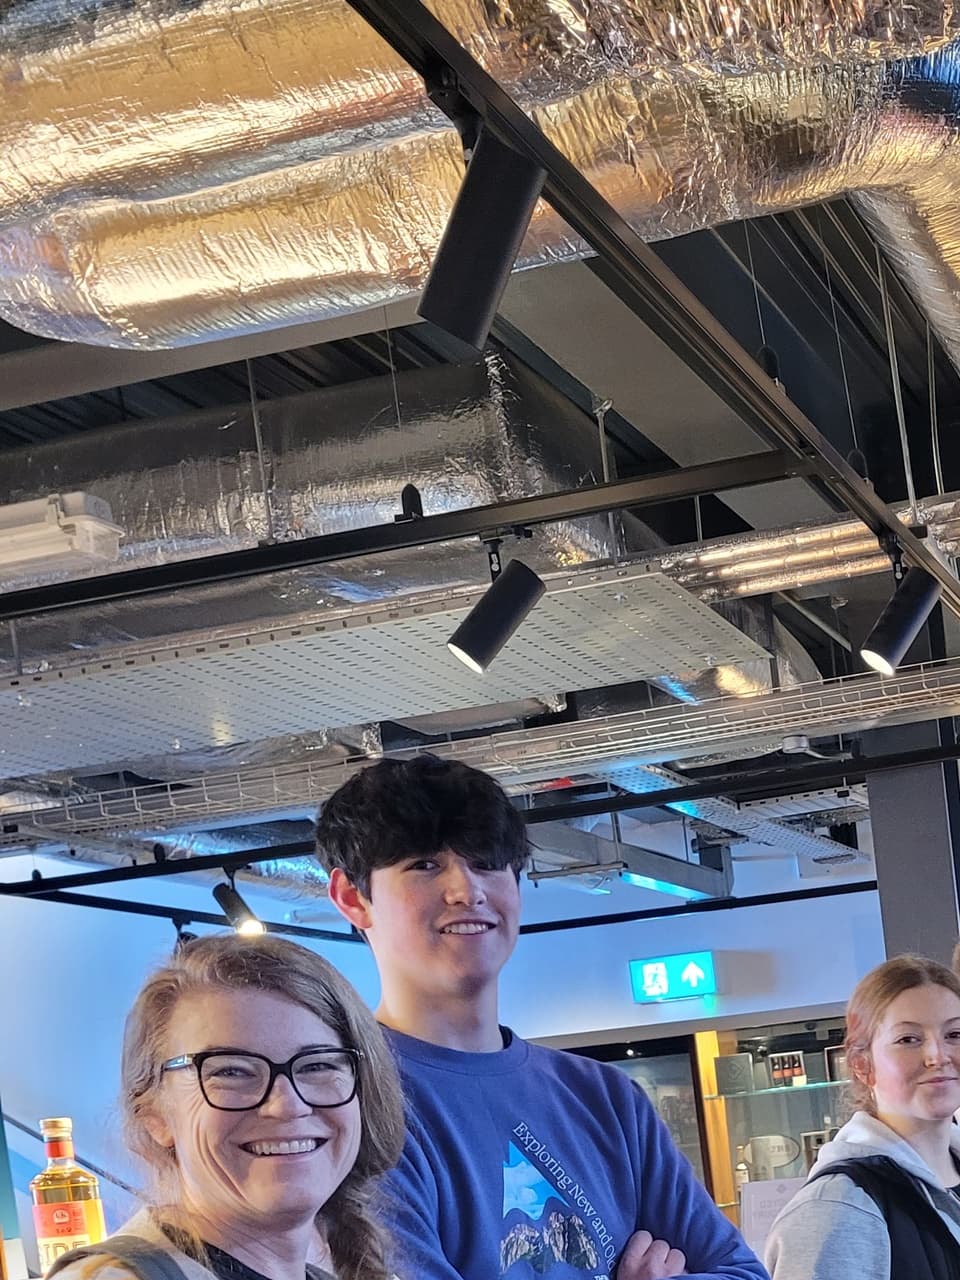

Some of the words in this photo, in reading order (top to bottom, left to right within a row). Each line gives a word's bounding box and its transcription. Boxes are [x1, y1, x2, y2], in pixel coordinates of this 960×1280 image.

[512, 1122, 573, 1190] Exploring
[567, 1183, 597, 1217] New
[591, 1217, 613, 1247] and
